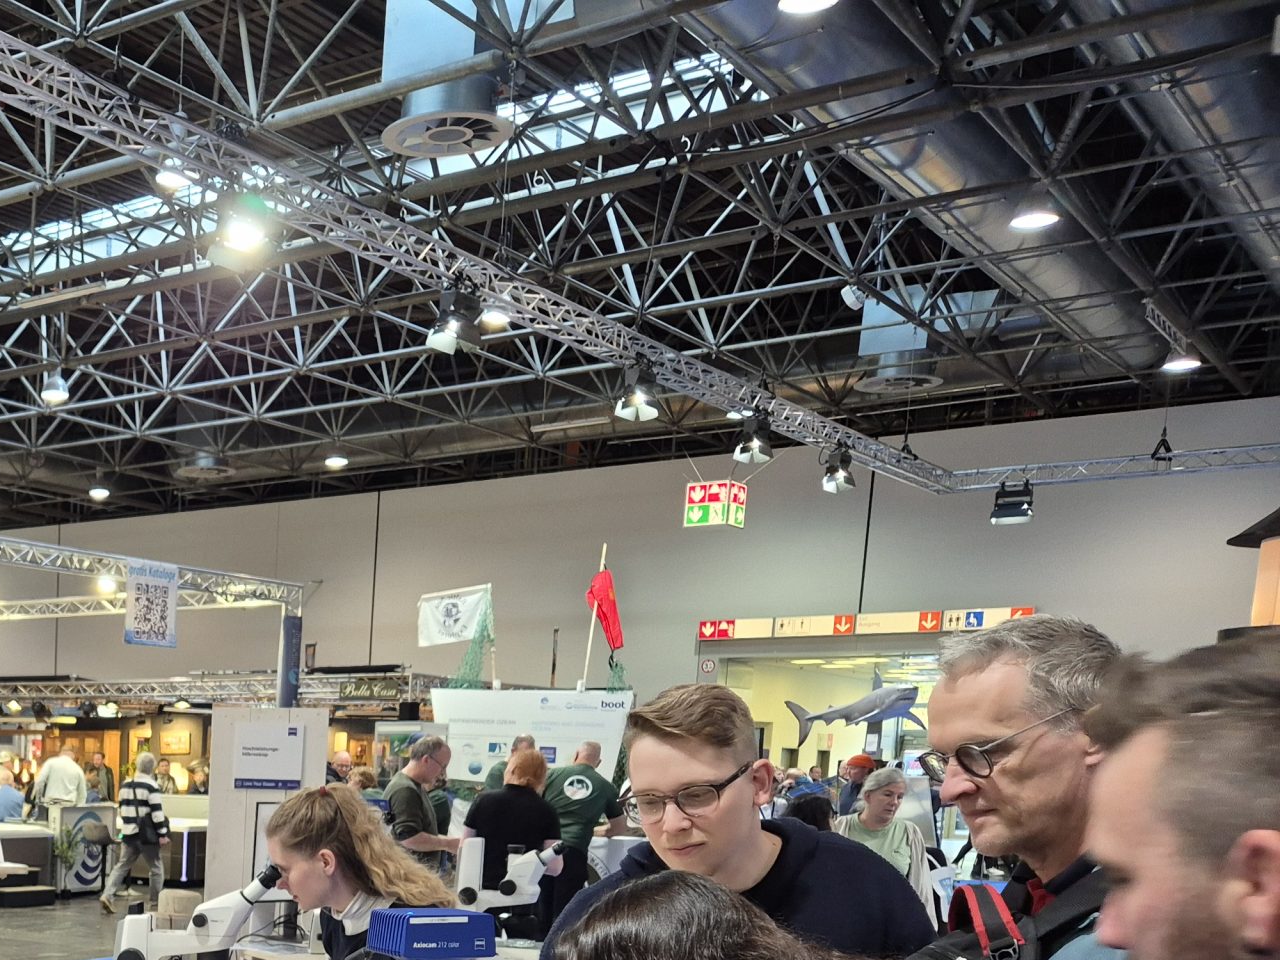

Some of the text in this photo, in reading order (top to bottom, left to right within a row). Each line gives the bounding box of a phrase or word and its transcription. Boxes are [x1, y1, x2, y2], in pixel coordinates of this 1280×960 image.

[341, 682, 396, 697] Bella Casa
[601, 700, 626, 709] boot
